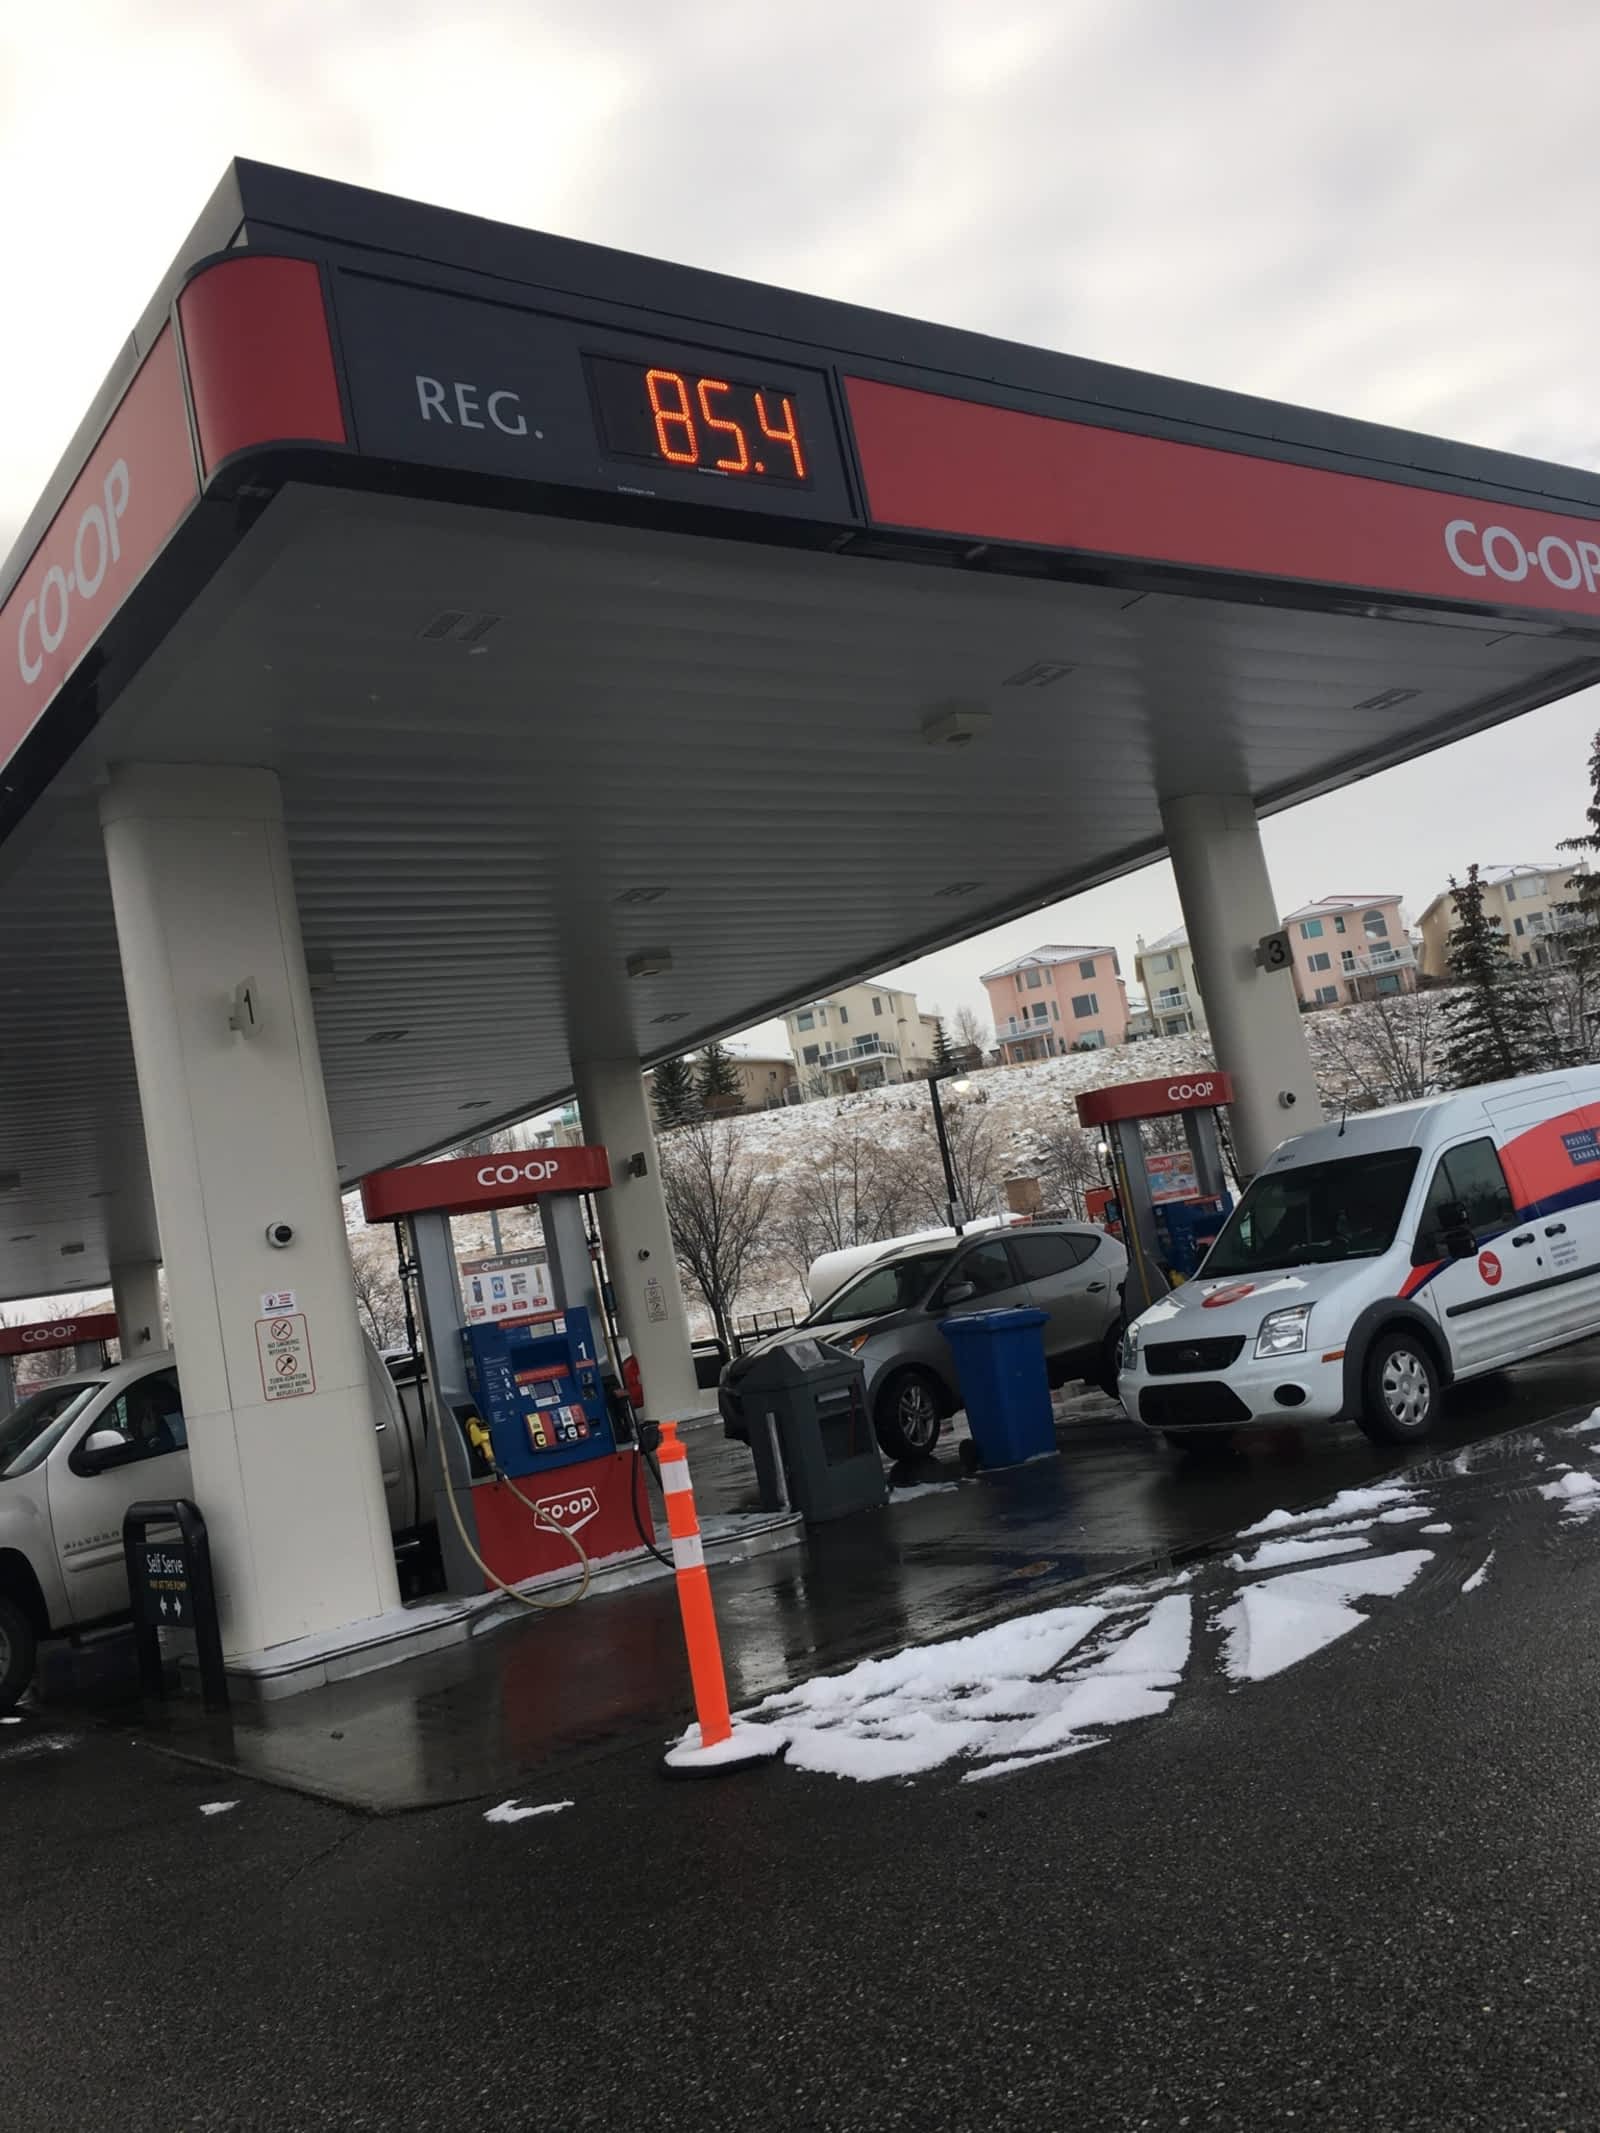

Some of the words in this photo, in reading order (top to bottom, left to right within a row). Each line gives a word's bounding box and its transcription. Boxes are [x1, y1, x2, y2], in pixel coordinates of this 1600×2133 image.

[415, 375, 544, 439] REG.
[646, 369, 806, 479] 85.4
[1269, 940, 1286, 964] 3
[243, 988, 255, 1025] 1
[578, 1341, 588, 1360] 1
[146, 1553, 161, 1574] Self
[161, 1553, 184, 1575] Serve
